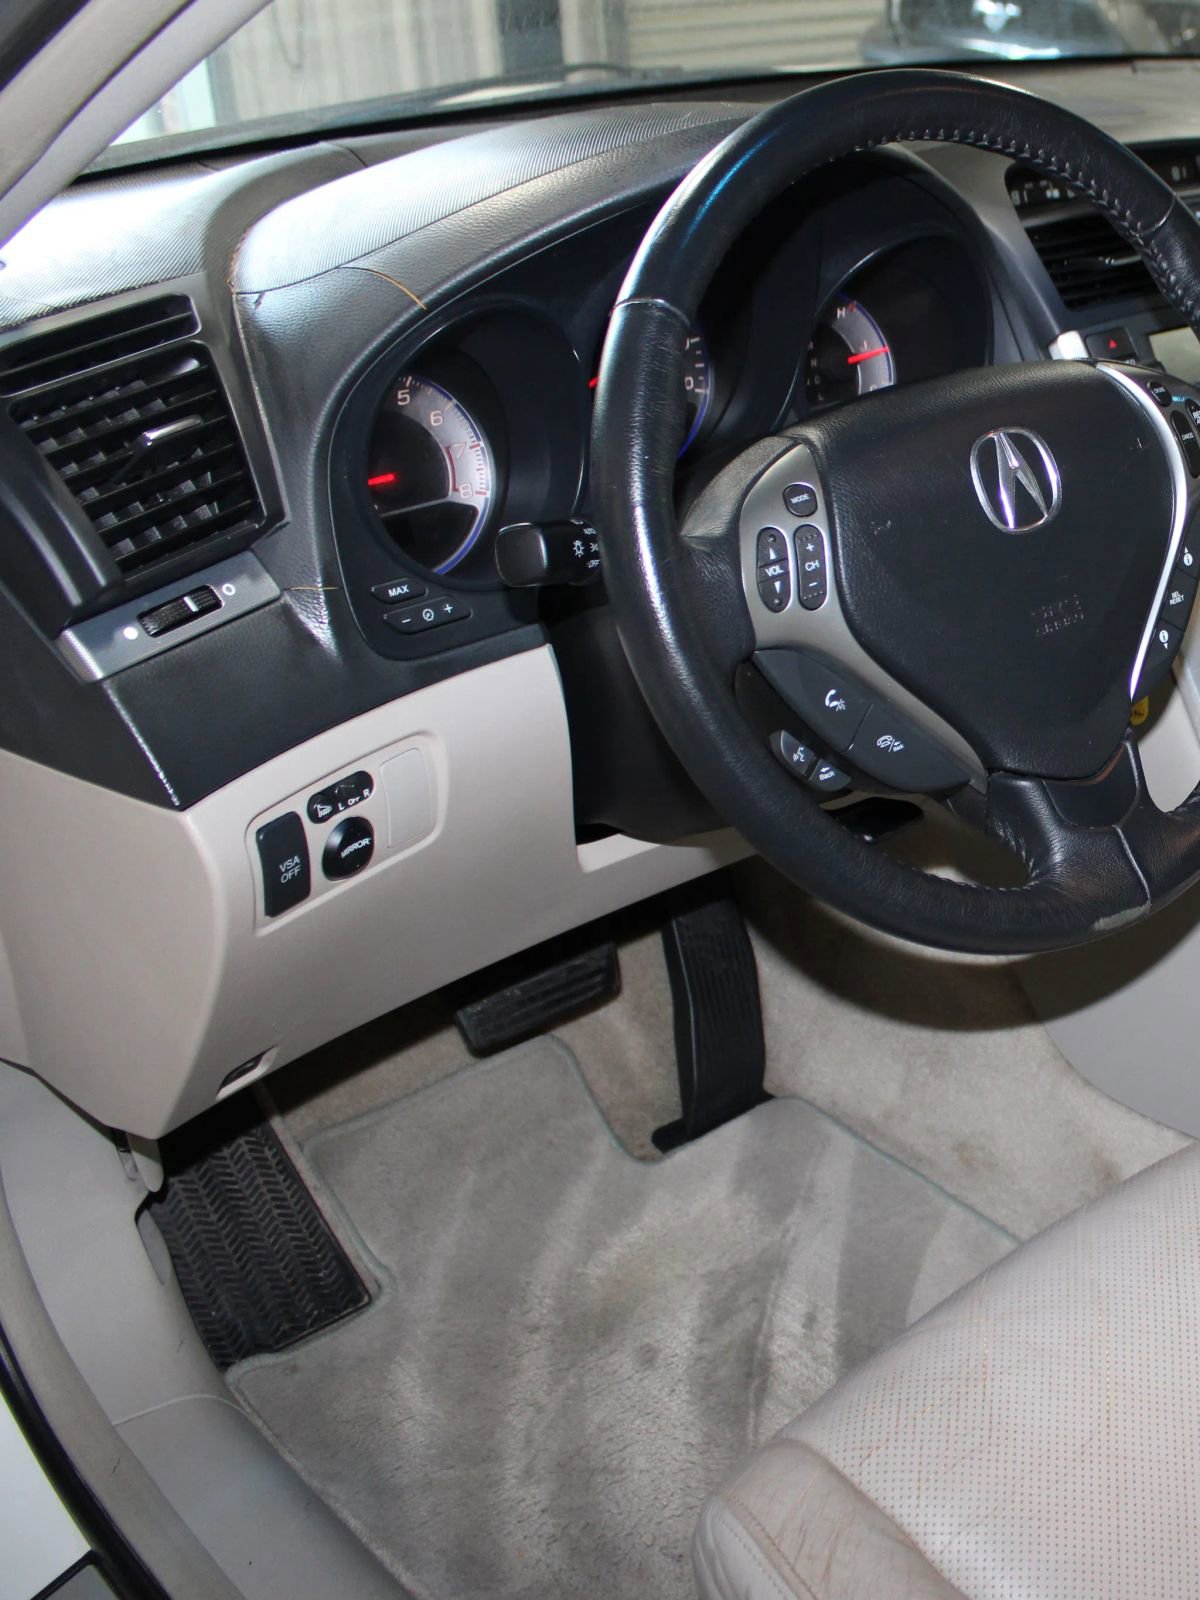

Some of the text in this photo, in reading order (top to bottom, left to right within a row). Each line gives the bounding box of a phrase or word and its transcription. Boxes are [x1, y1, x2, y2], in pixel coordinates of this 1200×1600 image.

[396, 388, 411, 406] 5
[429, 410, 444, 426] 6
[453, 442, 468, 459] 7
[458, 483, 474, 499] 8
[790, 493, 809, 503] MODE
[765, 564, 784, 577] VOL
[805, 559, 819, 572] CH
[387, 584, 409, 598] MAX
[819, 770, 835, 781] Back
[363, 788, 370, 798] R
[340, 837, 371, 858] MIRROR
[278, 855, 300, 873] VSA
[280, 865, 301, 884] OFF
